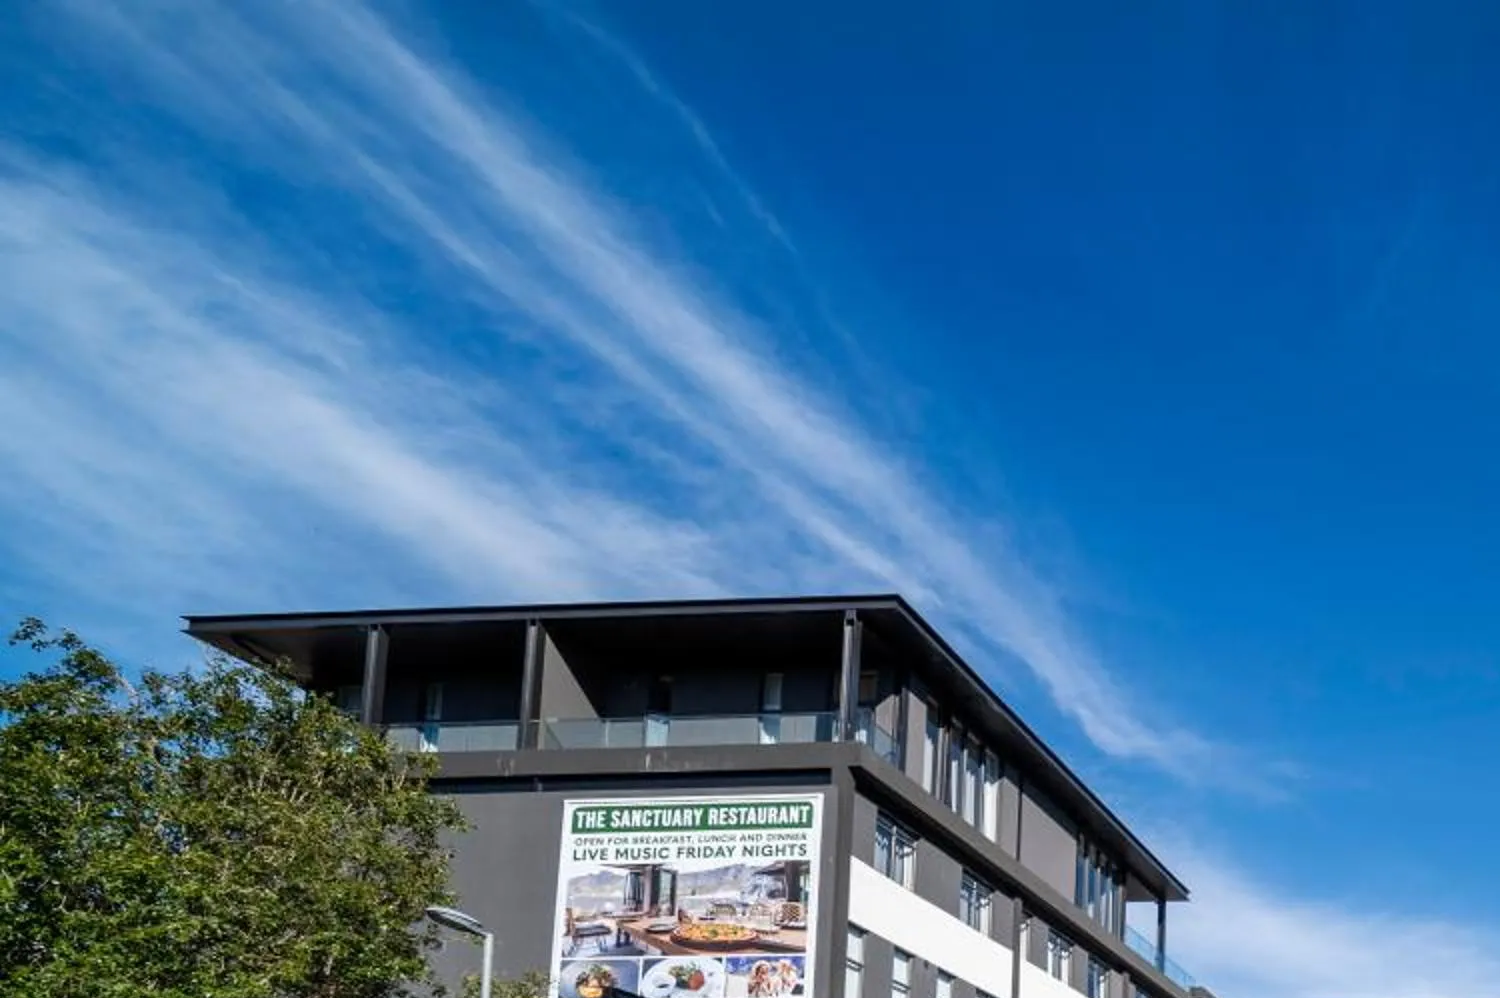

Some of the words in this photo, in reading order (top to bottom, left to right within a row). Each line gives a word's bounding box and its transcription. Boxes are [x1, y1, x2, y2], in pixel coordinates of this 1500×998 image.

[575, 810, 605, 829] THE
[610, 807, 703, 829] SANCTUARY
[710, 806, 811, 826] RESTAURANT
[574, 837, 605, 847] OPEN
[607, 836, 630, 846] FOR
[697, 834, 738, 844] LUNCH
[739, 833, 764, 842] AND
[766, 832, 808, 842] DINNER
[573, 849, 609, 861] LIVE
[615, 847, 670, 860] MUSIC
[677, 845, 737, 859] FRIDAY
[742, 844, 808, 857] NIGHTS
